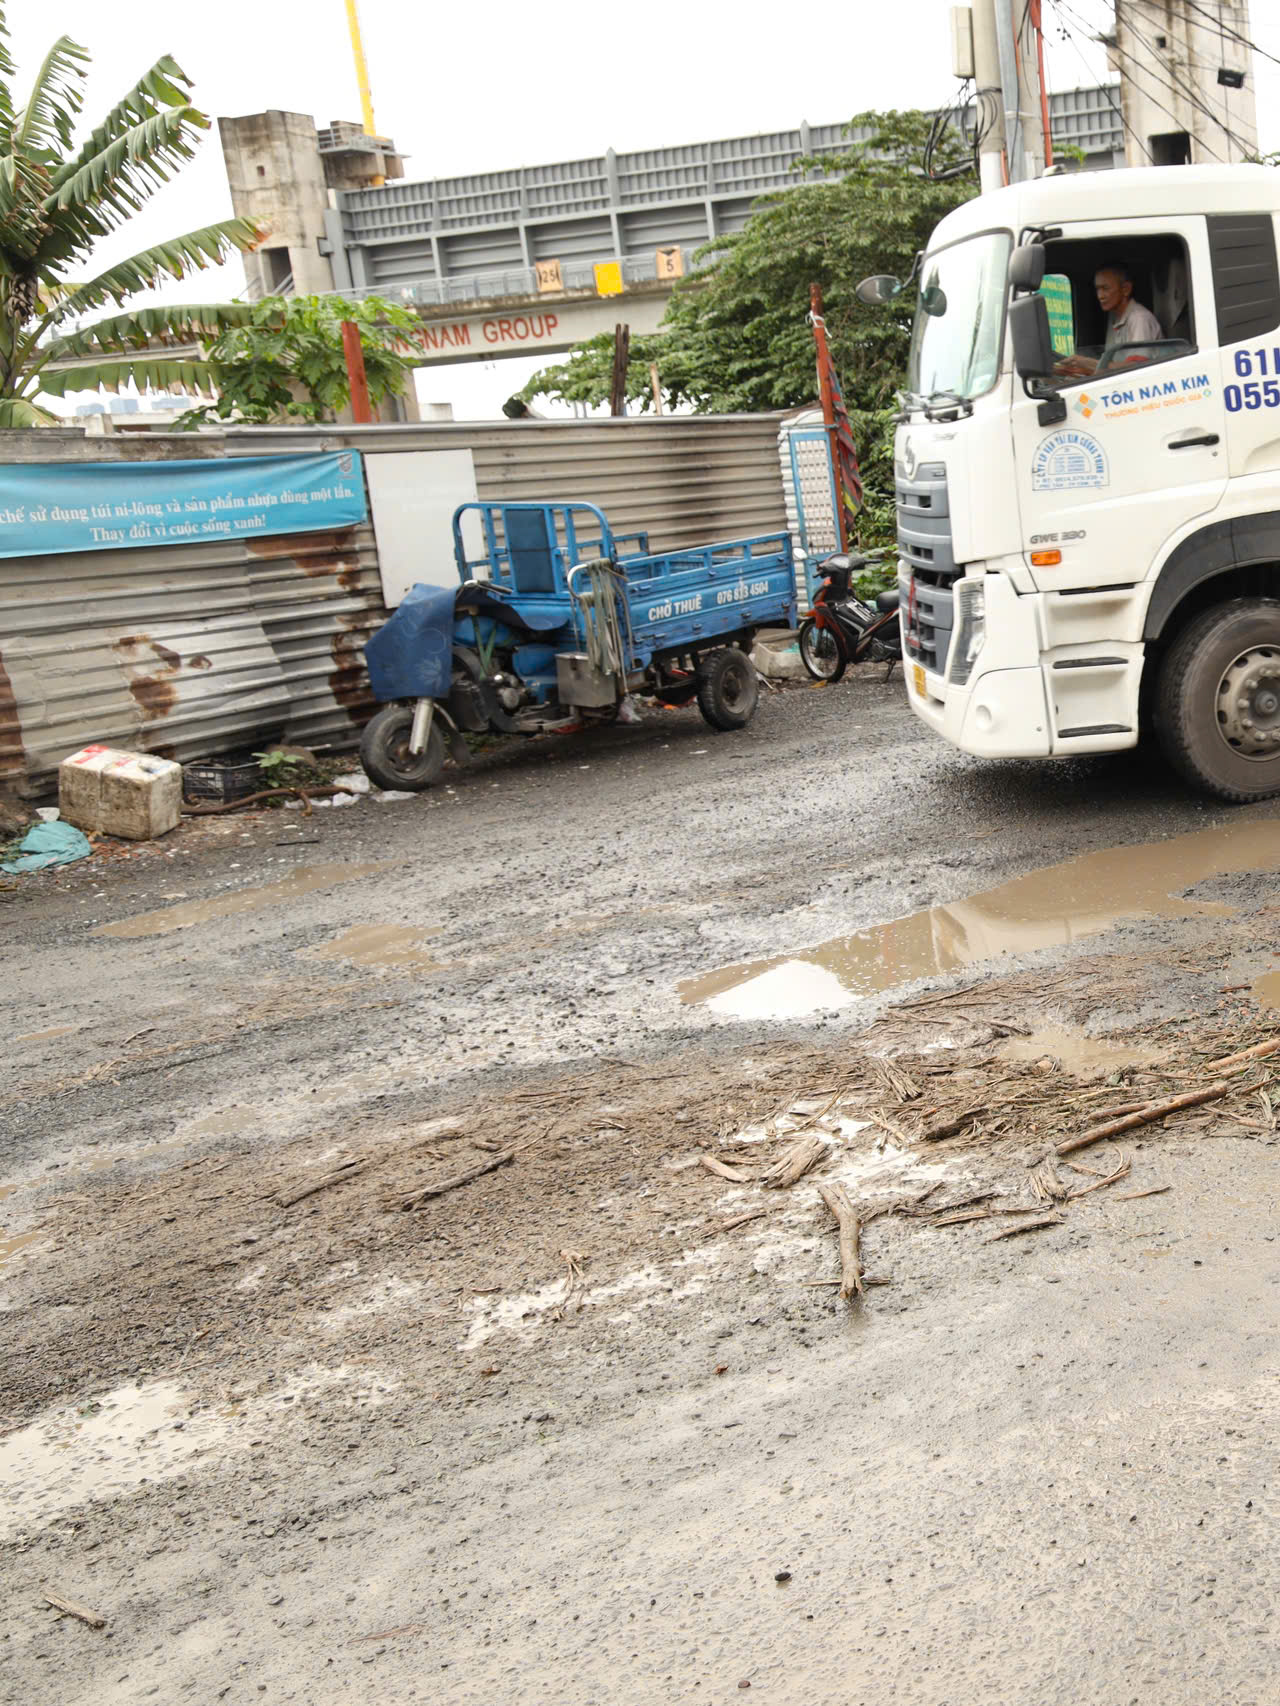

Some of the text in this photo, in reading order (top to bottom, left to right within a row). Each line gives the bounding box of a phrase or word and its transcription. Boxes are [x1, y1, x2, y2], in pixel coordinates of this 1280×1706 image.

[482, 314, 558, 344] GROUP
[1101, 374, 1210, 407] TÔN NAM KIM
[51, 506, 88, 524] dụng
[91, 503, 112, 518] túi
[115, 500, 163, 517] ni-lông
[166, 498, 181, 512] và
[90, 513, 266, 543] Thay đổi vì cuộc sống xanh!
[648, 599, 672, 621] CHỞ
[674, 594, 702, 615] THUÊ
[717, 589, 733, 605] 076
